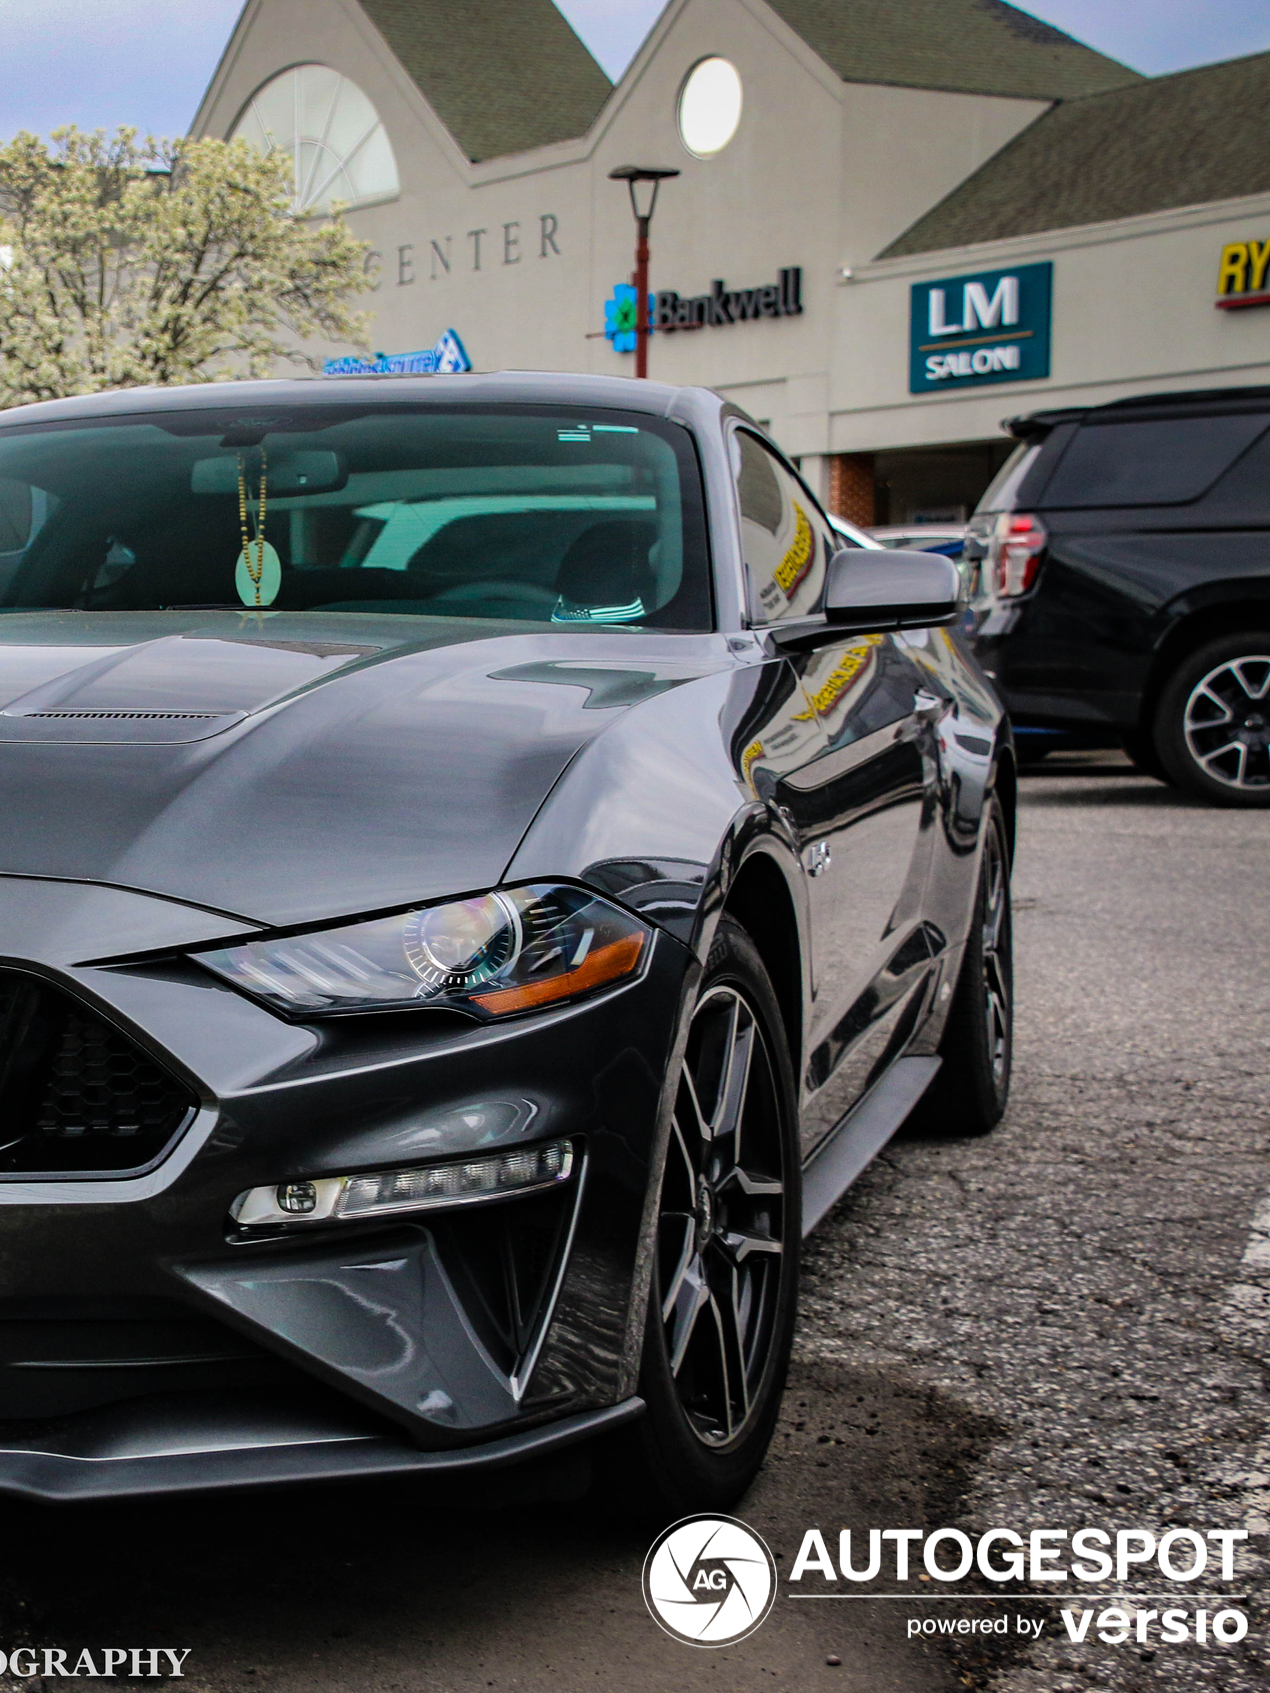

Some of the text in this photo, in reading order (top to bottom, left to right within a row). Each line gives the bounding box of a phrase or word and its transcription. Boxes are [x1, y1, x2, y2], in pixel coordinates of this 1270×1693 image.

[655, 265, 804, 335] Bankwell
[928, 275, 1020, 337] LM
[924, 345, 1021, 381] SALON
